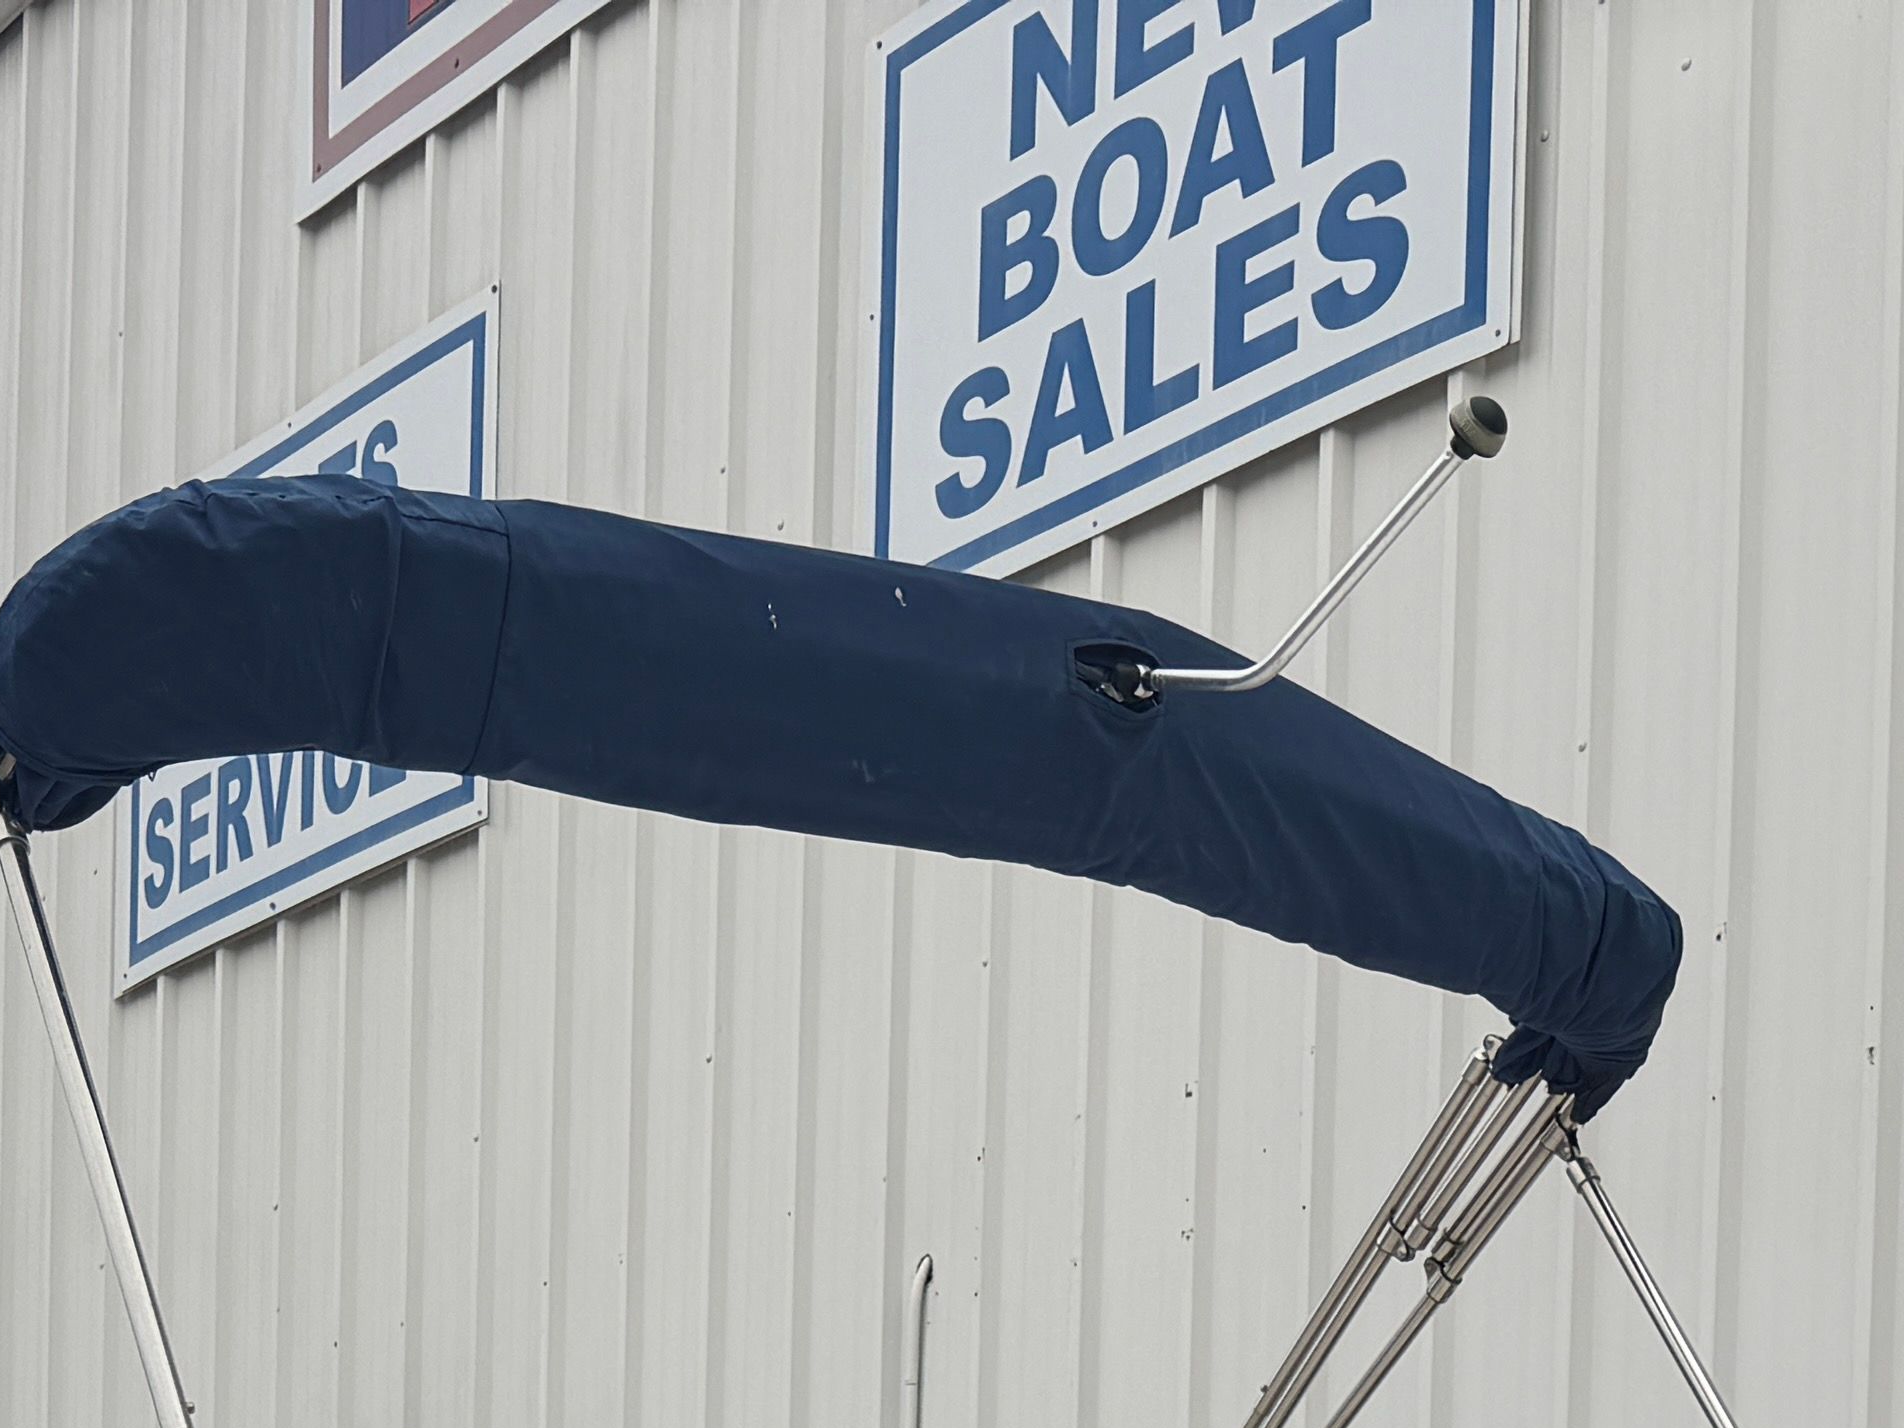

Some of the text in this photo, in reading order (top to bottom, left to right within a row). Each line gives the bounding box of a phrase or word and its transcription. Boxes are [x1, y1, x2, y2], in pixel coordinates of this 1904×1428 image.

[978, 0, 1373, 343] BOAT
[1009, 0, 1257, 161] NE
[935, 159, 1410, 519] SALES
[144, 752, 407, 909] SERVIC
